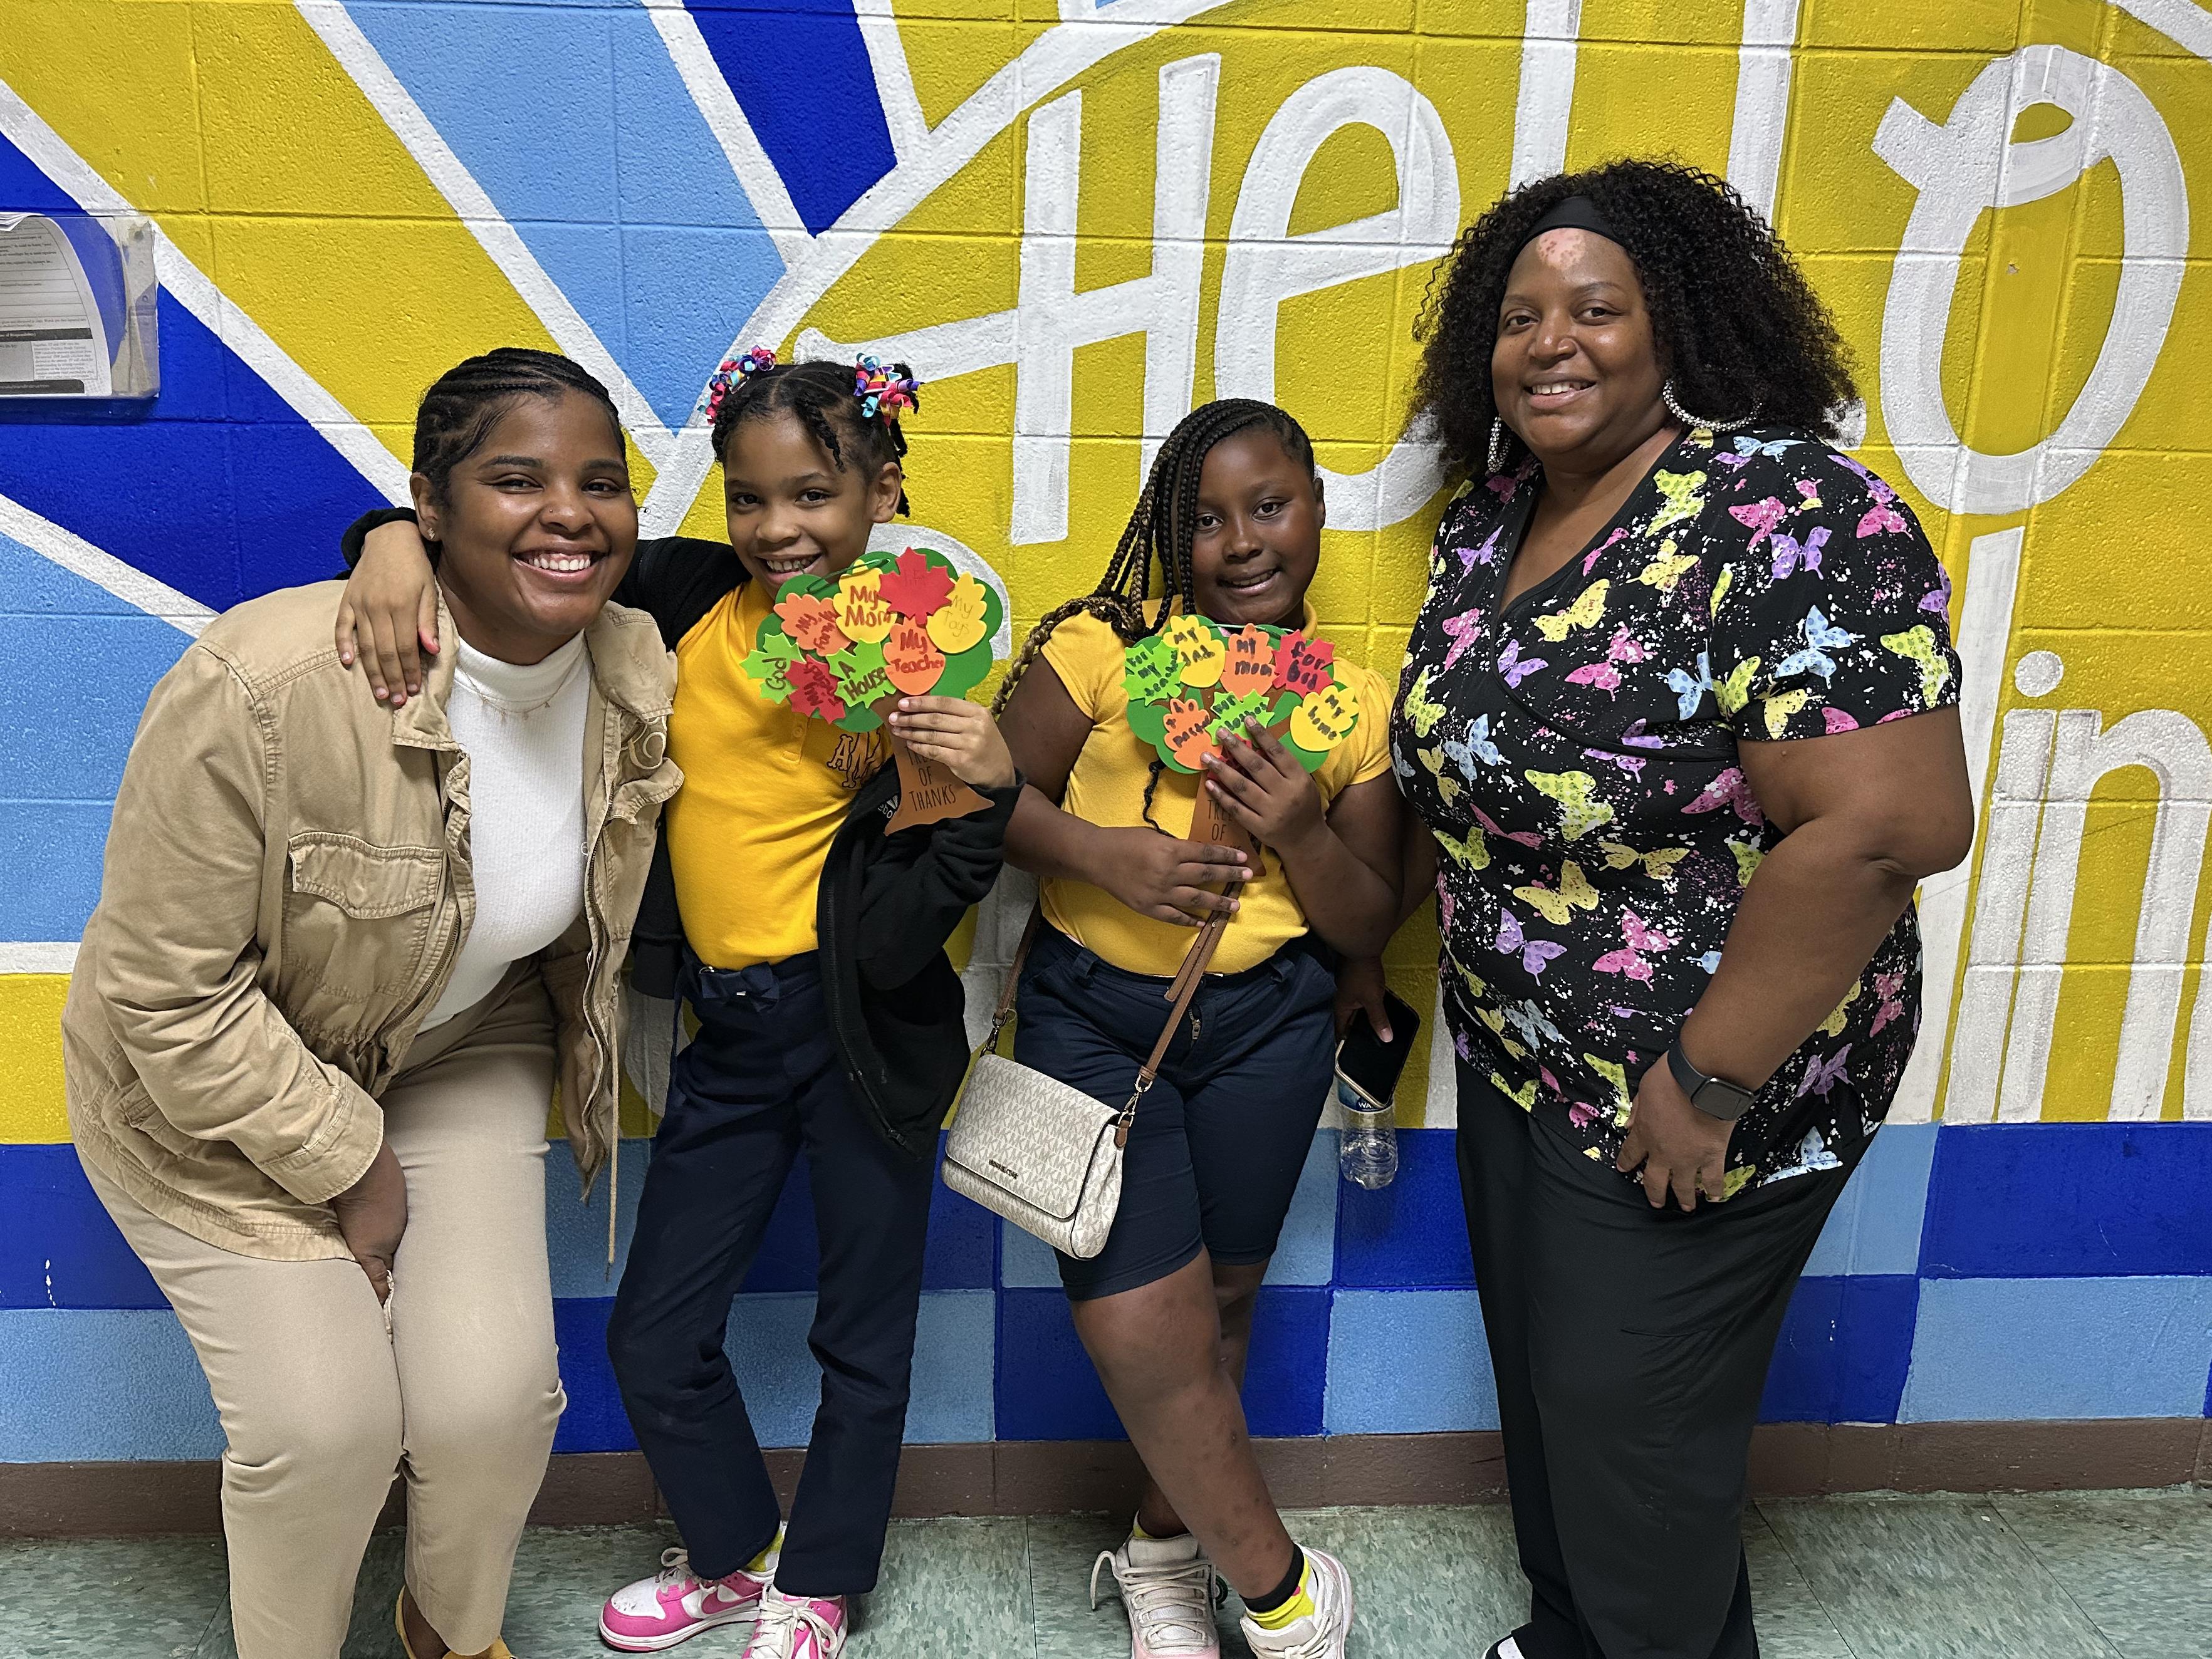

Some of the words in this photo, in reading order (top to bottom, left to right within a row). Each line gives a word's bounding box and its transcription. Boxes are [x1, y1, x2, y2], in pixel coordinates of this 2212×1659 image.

[850, 585, 879, 611] My
[951, 595, 973, 619] My
[795, 613, 818, 635] My
[845, 605, 892, 627] Mom
[900, 628, 927, 655] My
[762, 657, 787, 691] God
[838, 660, 856, 679] A
[843, 666, 889, 702] House
[918, 766, 932, 786] OF
[909, 784, 956, 811] THANKS
[1211, 823, 1227, 841] OF
